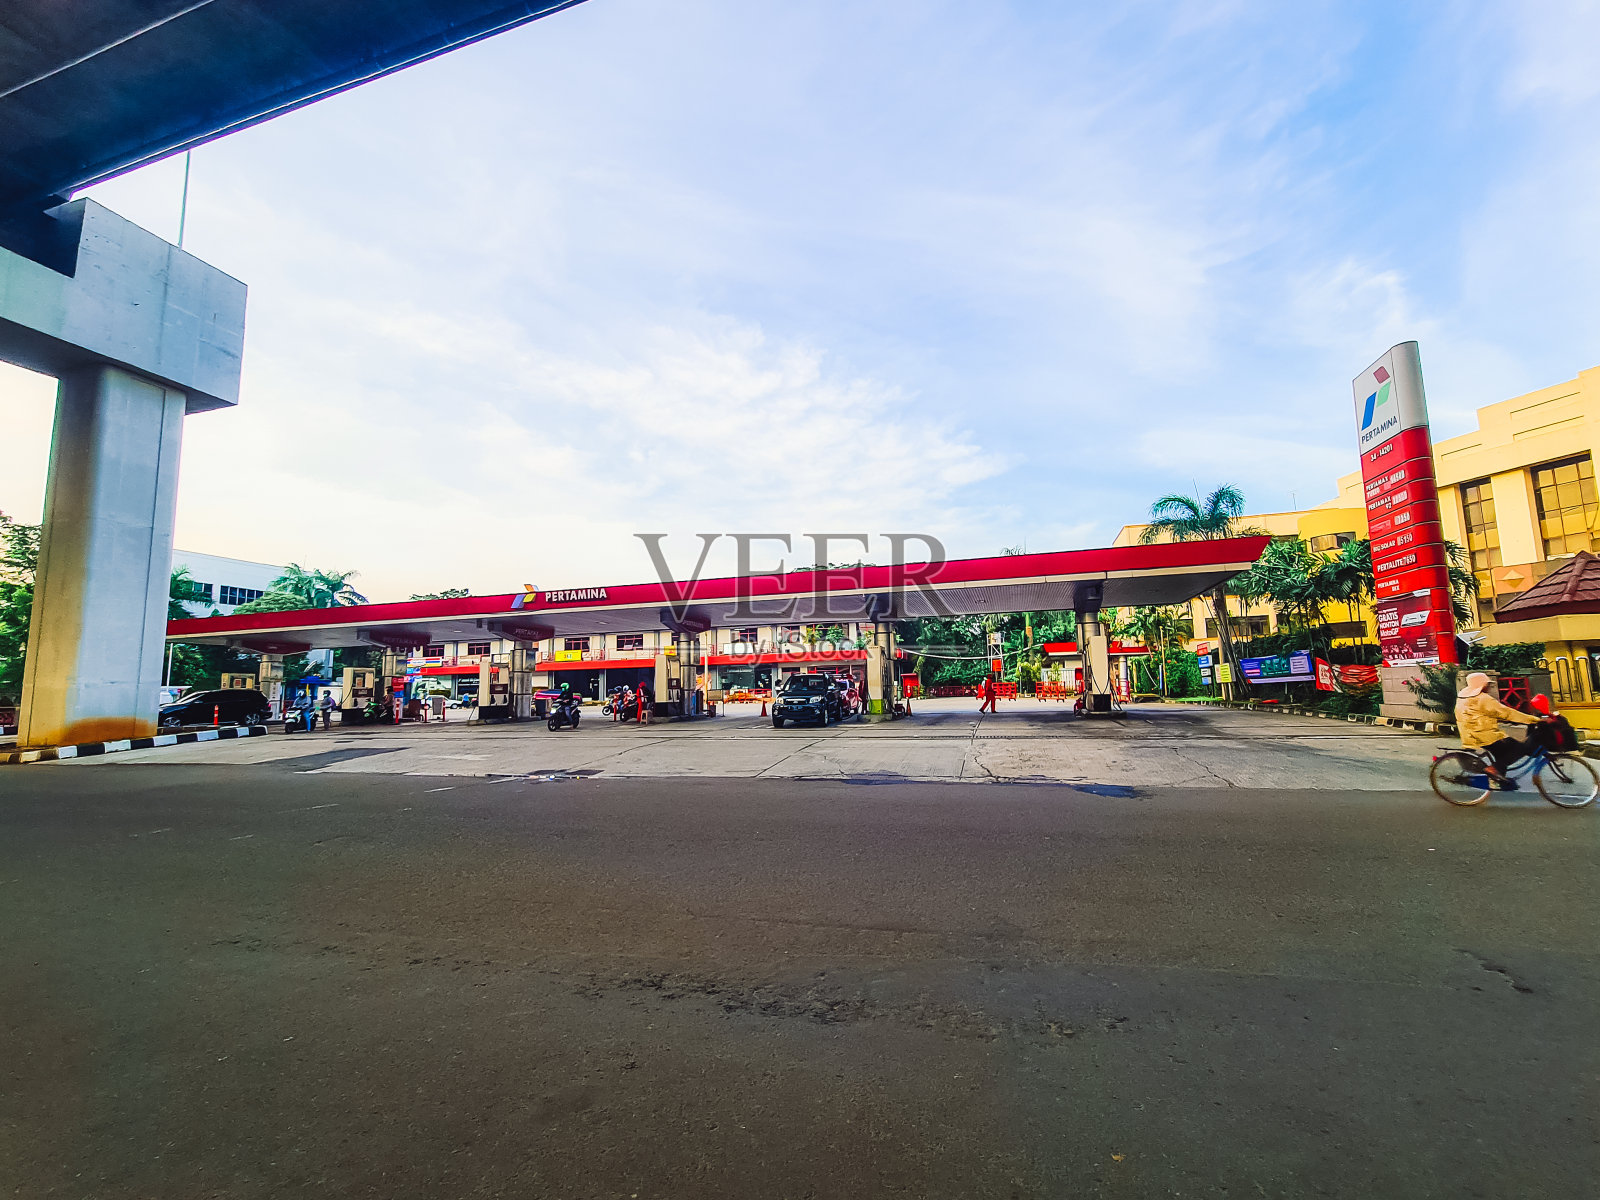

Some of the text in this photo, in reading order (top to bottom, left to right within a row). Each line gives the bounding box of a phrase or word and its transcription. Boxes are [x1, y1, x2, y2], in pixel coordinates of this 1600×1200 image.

[1361, 415, 1398, 444] PERTAMINA
[1366, 476, 1389, 491] PERTAMAX
[1368, 496, 1391, 510] PERTAMAX
[1380, 540, 1396, 550] SOLAR
[1377, 558, 1403, 573] PERTALITE
[545, 588, 607, 602] PERTAMINA
[1378, 612, 1399, 622] GRATIS
[1379, 621, 1400, 629] NONTON
[1380, 628, 1399, 637] MotoGP
